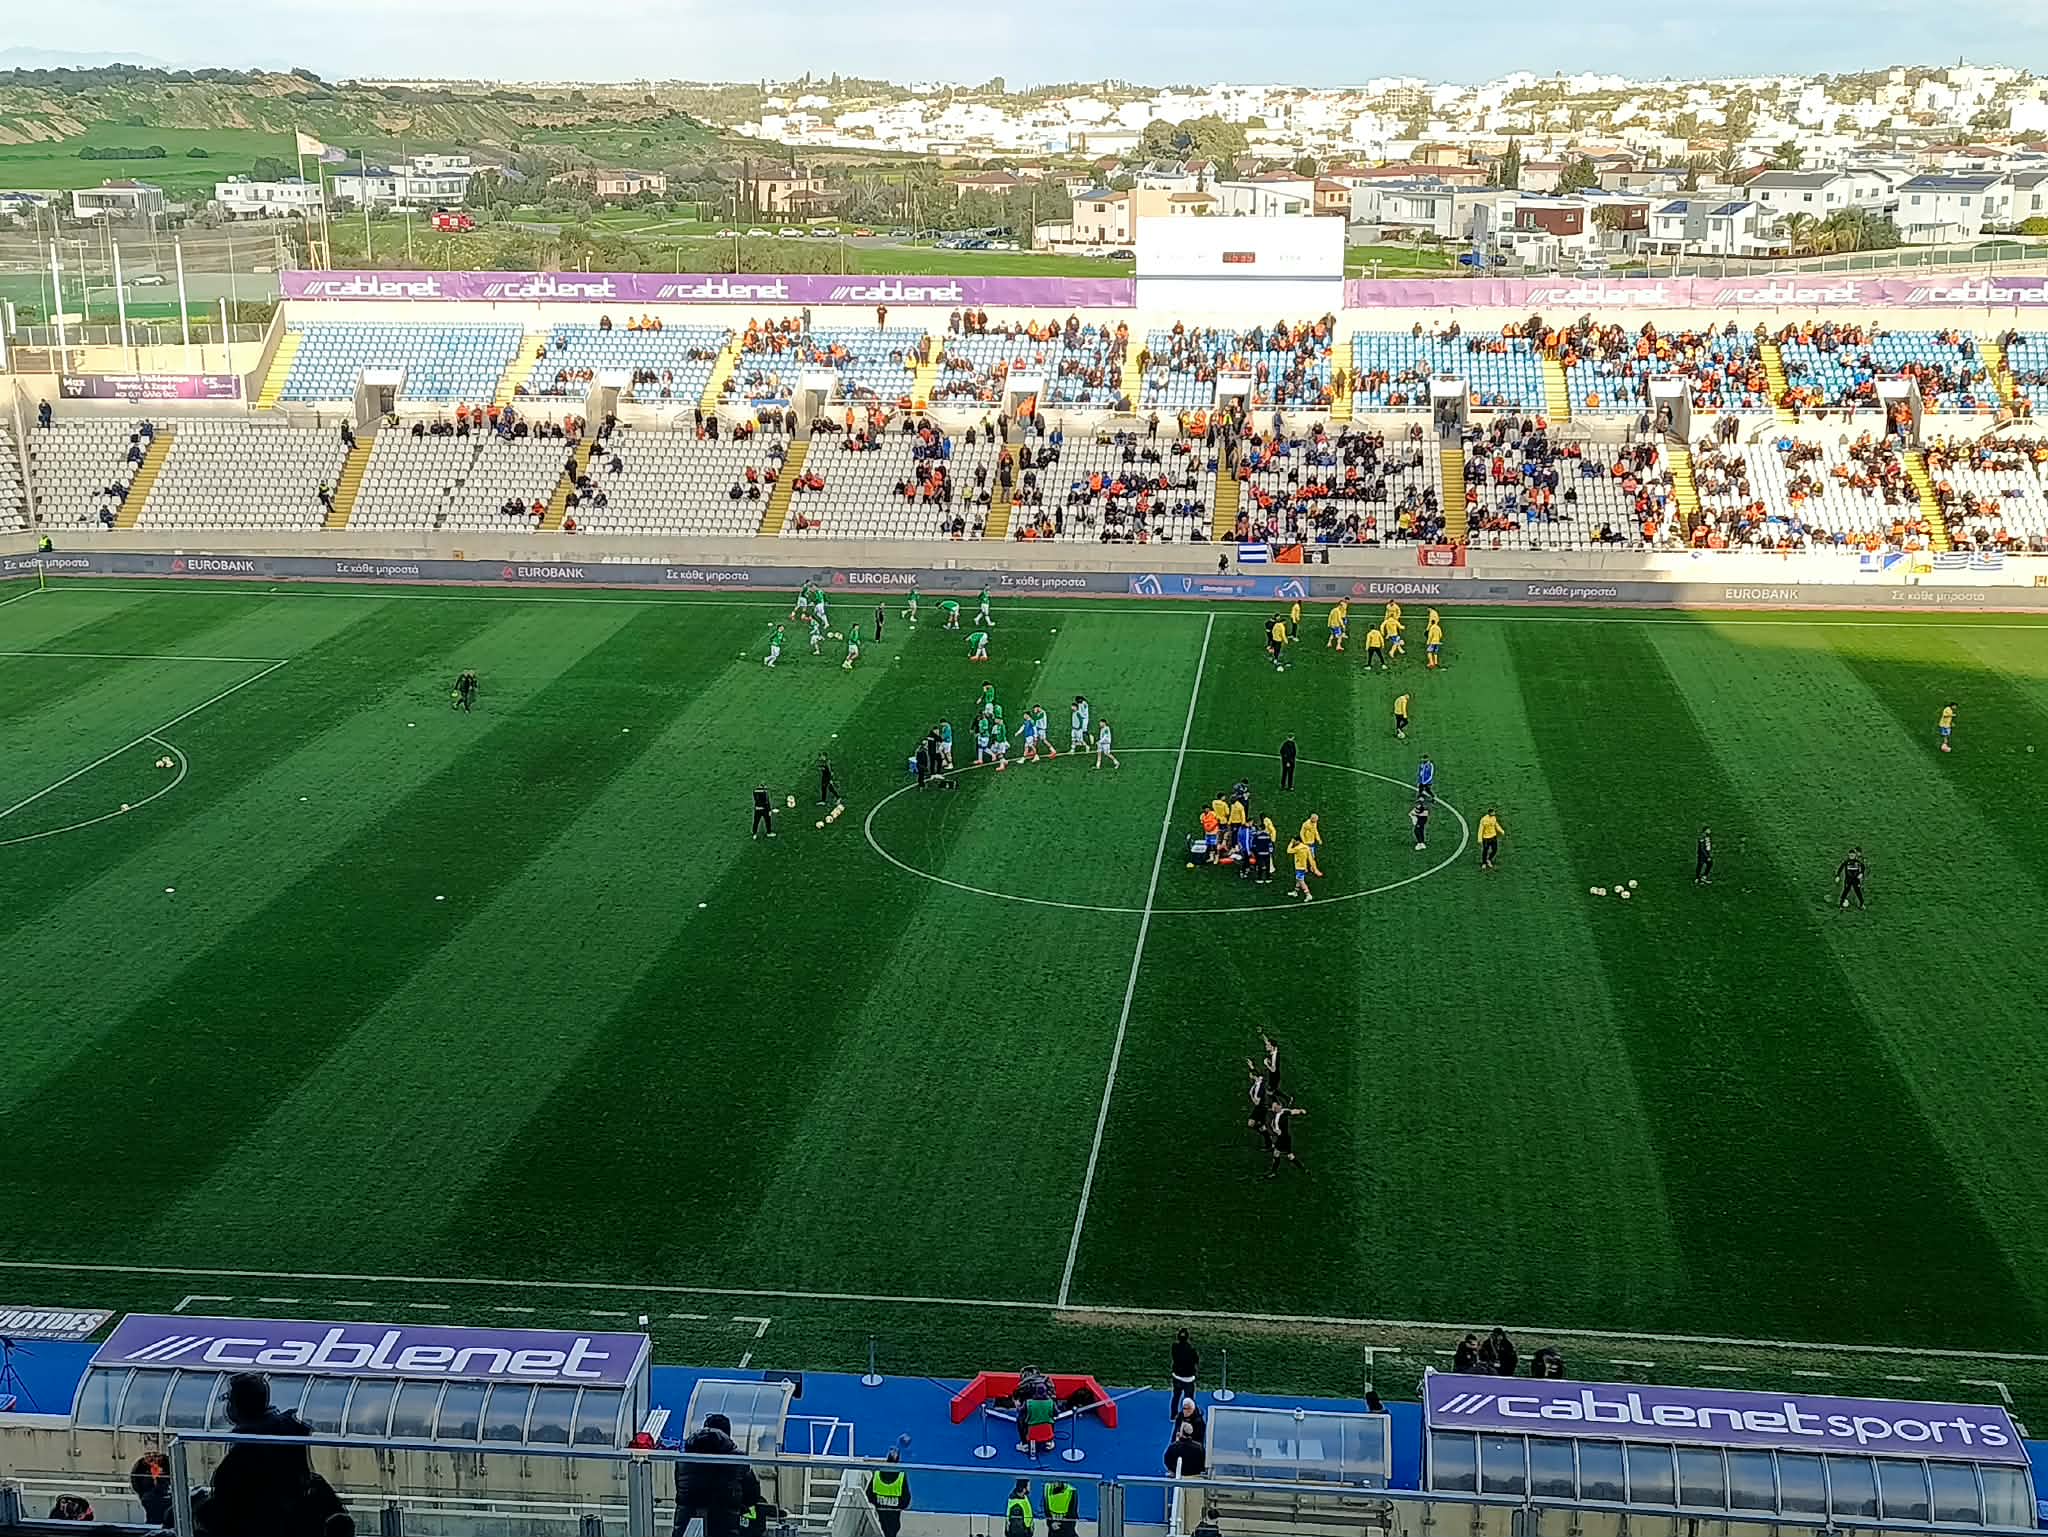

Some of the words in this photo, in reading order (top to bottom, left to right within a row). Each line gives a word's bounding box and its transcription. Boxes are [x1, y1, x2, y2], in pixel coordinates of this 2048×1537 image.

[324, 276, 441, 297] cablenet
[504, 277, 616, 298] cablenet
[677, 278, 789, 298] cablenet
[850, 280, 963, 301] cablenet
[1735, 281, 1861, 303] cablenet
[1549, 282, 1670, 304] cablenet
[67, 387, 82, 395] TV
[4, 560, 16, 570] Σε
[188, 560, 254, 571] EUROBANK
[336, 563, 348, 573] Σε
[376, 565, 419, 575] μπροστά
[518, 567, 584, 578] EUROBANK
[666, 569, 679, 579] Σε
[706, 571, 749, 581] μπροστά
[849, 573, 916, 584] EUROBANK
[1001, 576, 1013, 586] Σε
[1042, 578, 1086, 588] μπροστά
[1369, 583, 1439, 594] EUROBANK
[1527, 585, 1540, 596] Σε
[1570, 587, 1617, 597] μπροστά
[1725, 588, 1798, 600] EUROBANK
[202, 1328, 609, 1378] cablenet
